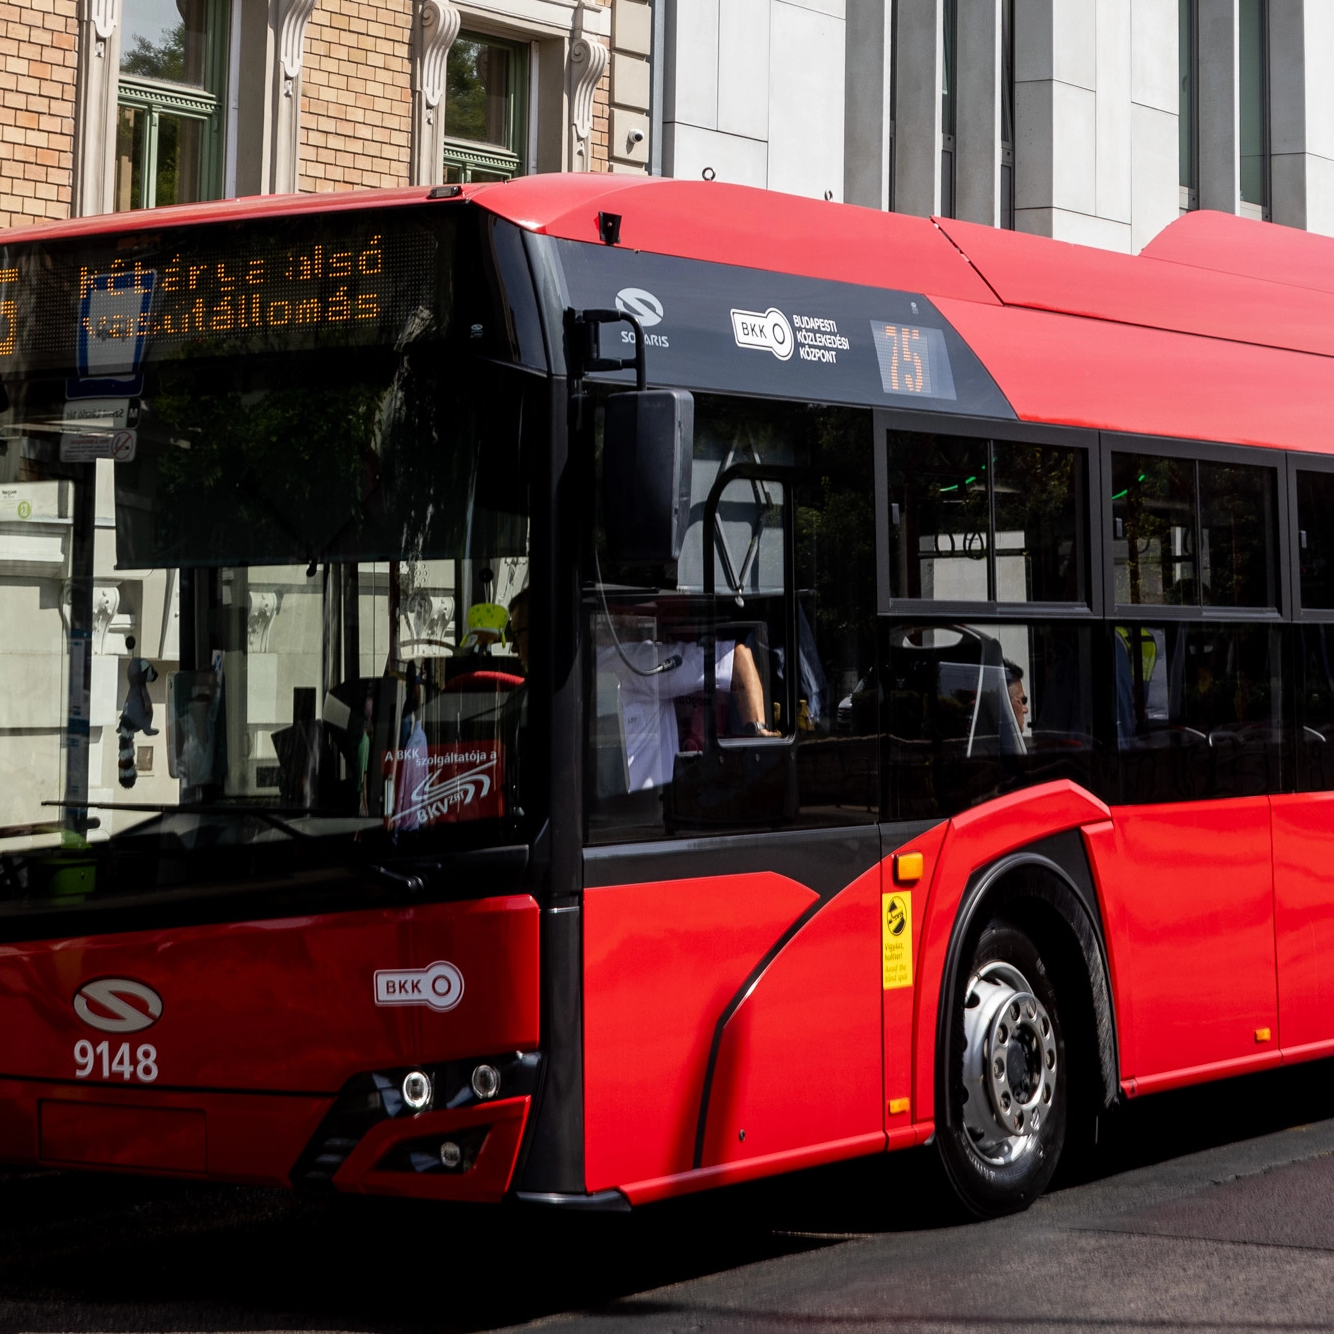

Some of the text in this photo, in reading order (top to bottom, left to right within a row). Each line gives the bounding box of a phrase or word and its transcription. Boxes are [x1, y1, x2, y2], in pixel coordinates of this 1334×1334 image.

[741, 321, 768, 339] BKK
[793, 314, 837, 333] BUDAPESTI
[620, 331, 669, 348] SOARIS
[796, 329, 850, 350] KÖZLEKEDÉSI
[799, 345, 836, 364] KÖZPONT
[882, 325, 924, 392] 75
[385, 748, 497, 766] A BKK szolgáltatója a
[417, 798, 449, 824] BKV
[386, 979, 423, 995] BKK
[74, 1039, 159, 1083] 9148
